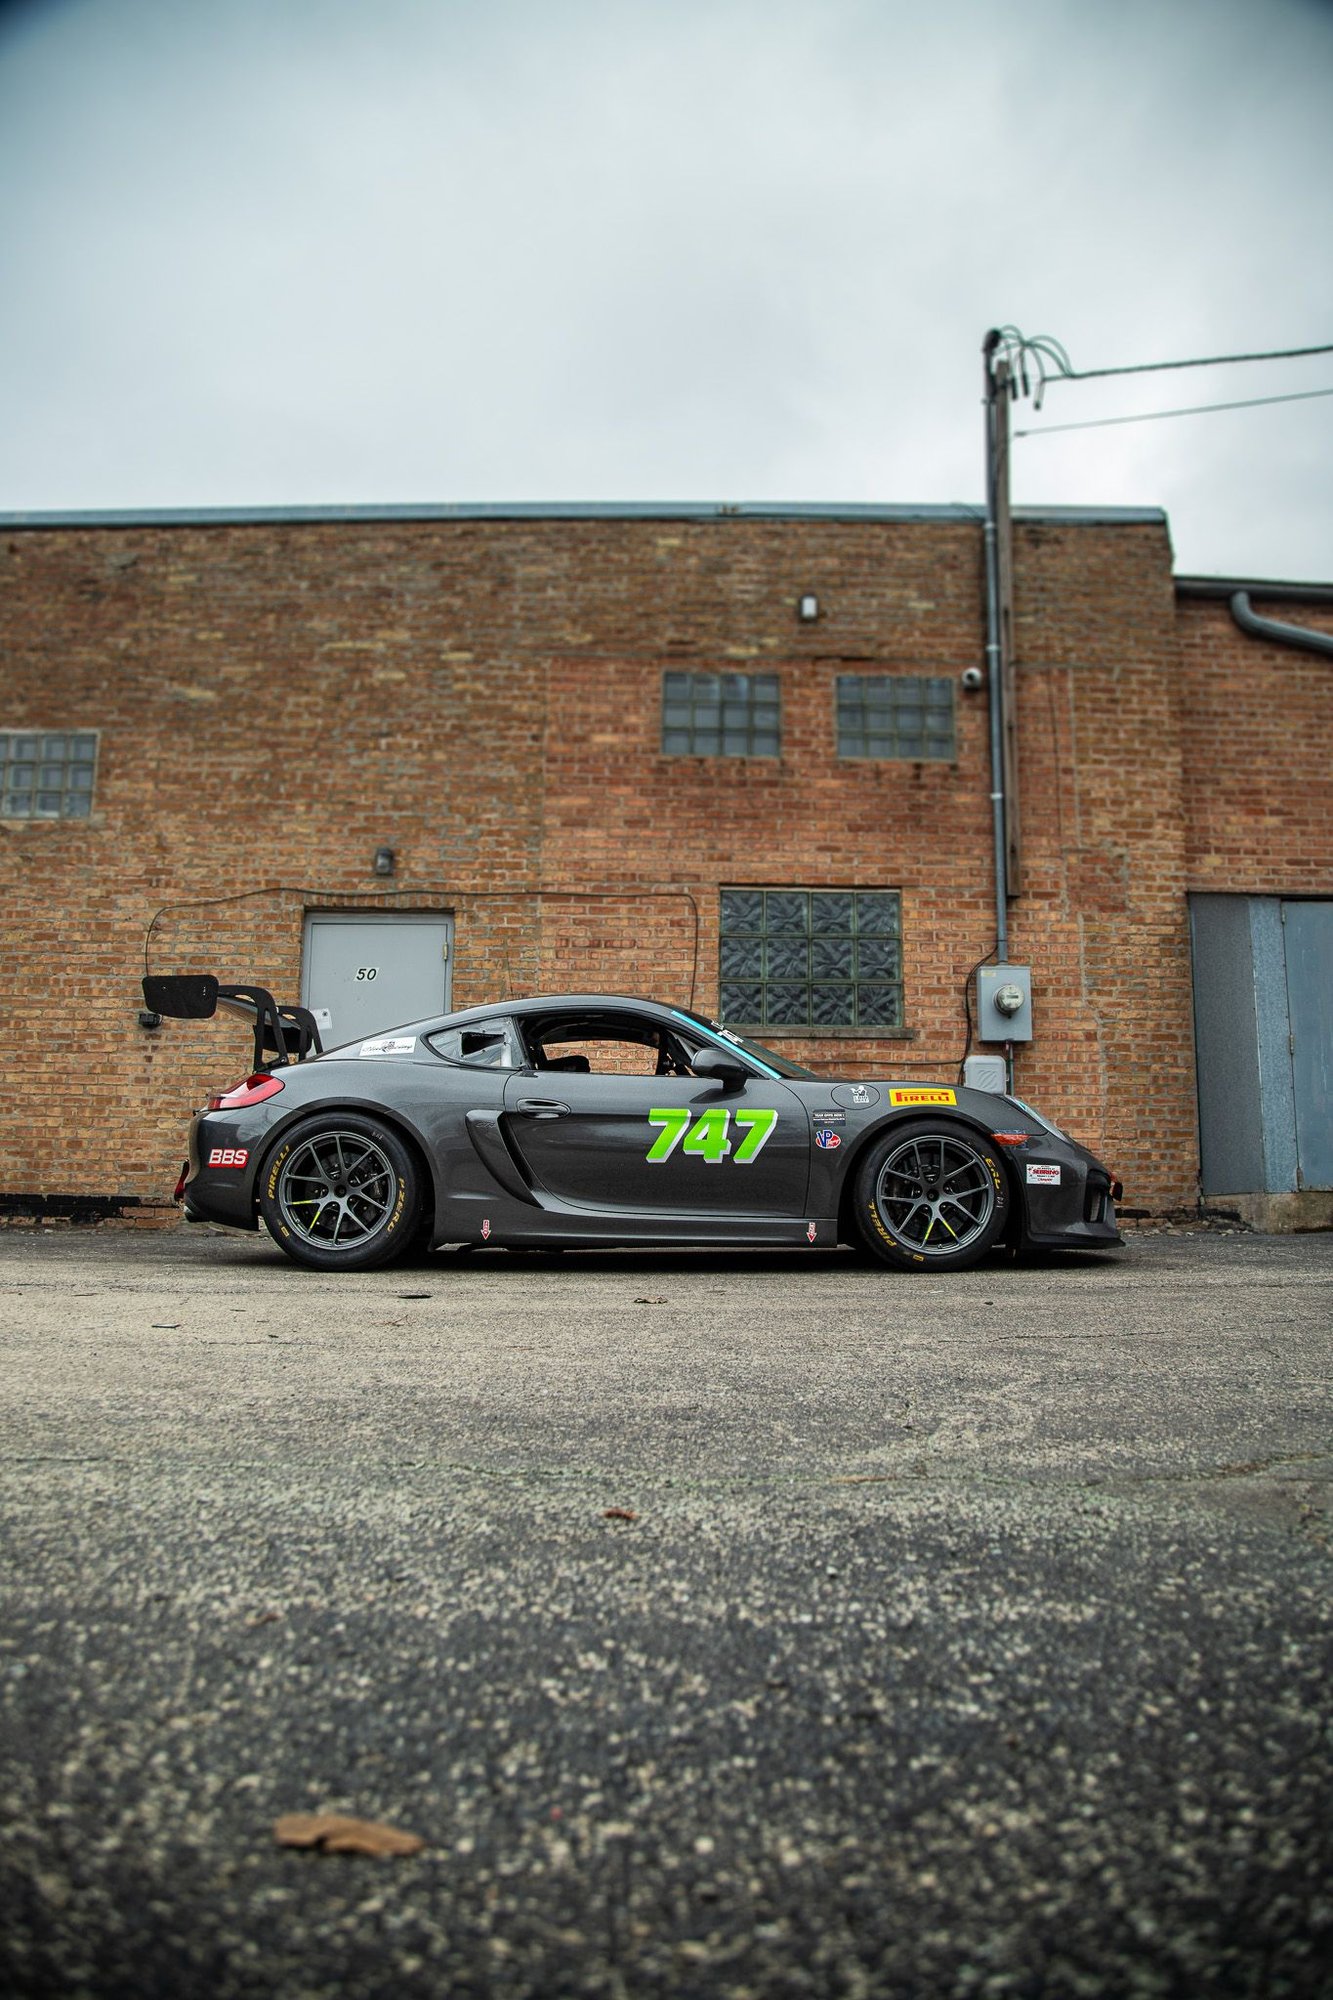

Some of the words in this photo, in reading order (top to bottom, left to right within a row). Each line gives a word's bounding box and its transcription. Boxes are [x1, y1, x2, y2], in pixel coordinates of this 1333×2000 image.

[356, 968, 377, 981] 50
[895, 1091, 950, 1102] PIRELLI
[646, 1108, 778, 1164] 747
[816, 1130, 833, 1148] VP
[208, 1148, 248, 1167] BBS
[266, 1144, 290, 1200] PIRELLI
[868, 1199, 897, 1248] PIRELL
